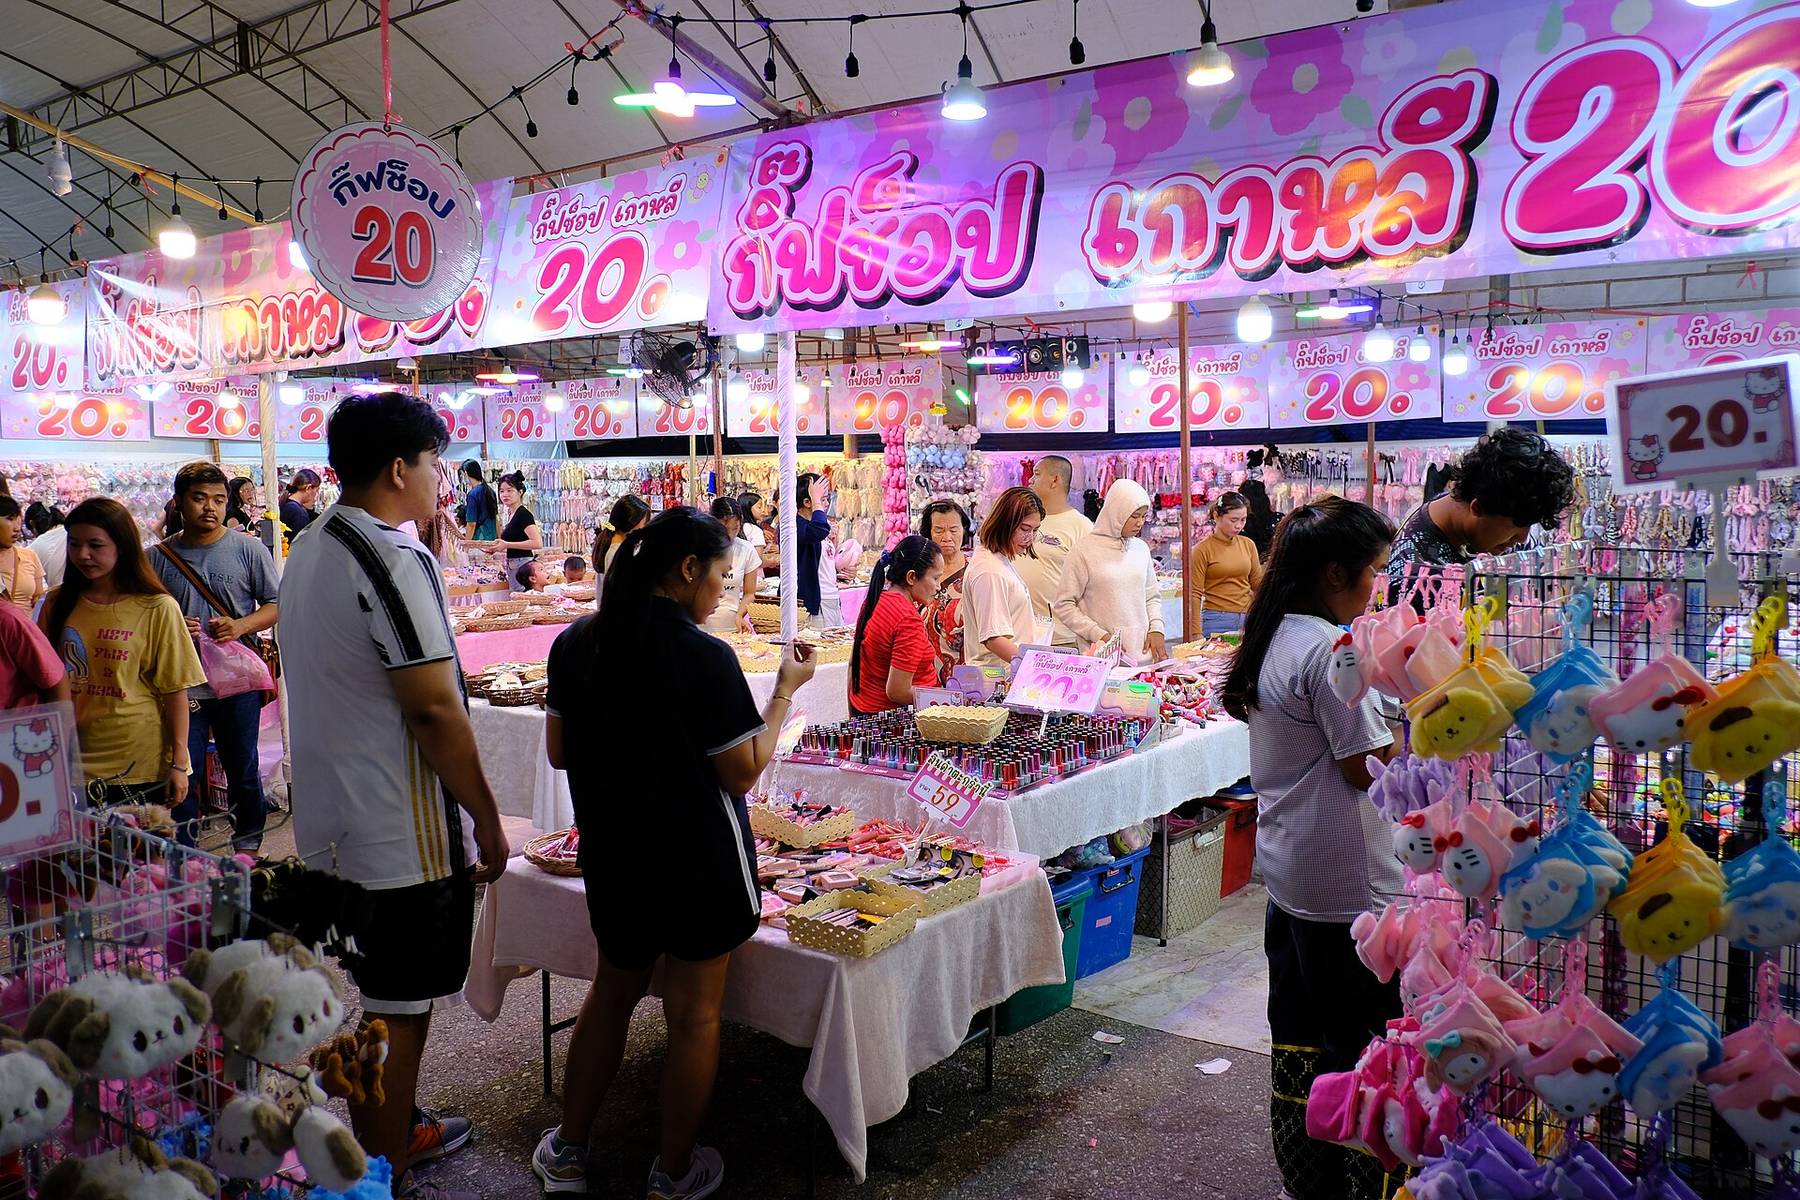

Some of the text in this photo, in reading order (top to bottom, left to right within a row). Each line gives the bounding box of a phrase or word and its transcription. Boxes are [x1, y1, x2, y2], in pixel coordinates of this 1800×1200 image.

[328, 159, 456, 219] กิ๊ฟช็อป
[613, 178, 684, 224] เกาหลี
[1083, 70, 1498, 288] เกาหลี
[352, 205, 437, 289] 20
[1196, 353, 1241, 374] เกาหลี
[1550, 331, 1610, 353] เกาหลี
[1665, 399, 1768, 453] 20.
[930, 785, 960, 812] 59
